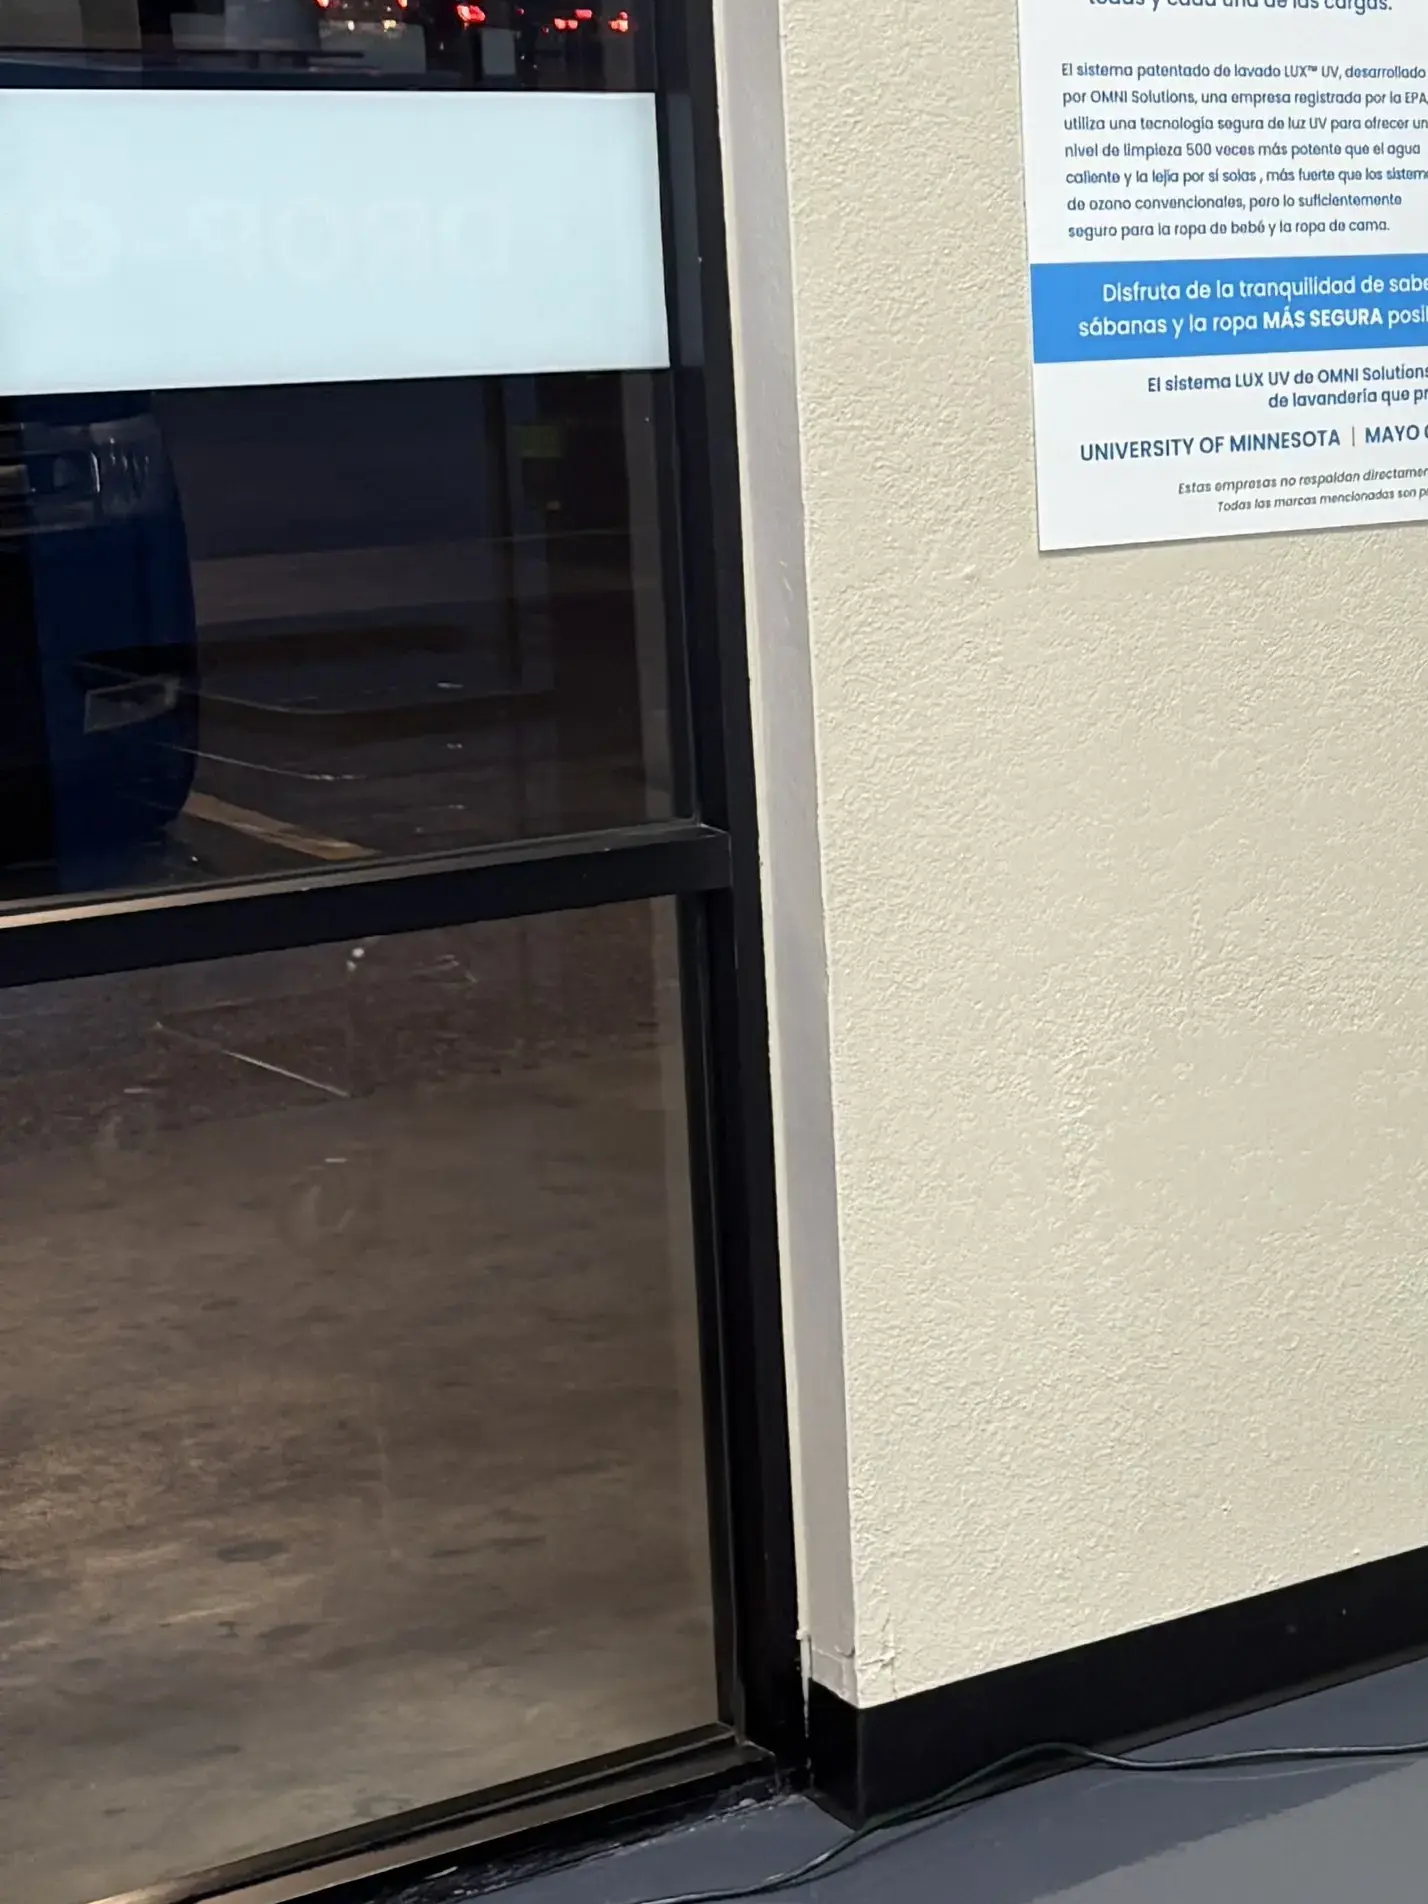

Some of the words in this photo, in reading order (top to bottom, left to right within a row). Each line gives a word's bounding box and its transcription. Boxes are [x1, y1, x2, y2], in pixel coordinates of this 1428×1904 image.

[1062, 92, 1086, 107] por
[1089, 90, 1127, 103] OMNI
[1131, 89, 1198, 105] Solutions,
[1201, 92, 1227, 103] una
[1230, 92, 1291, 108] empresa
[1294, 90, 1361, 108] registrada
[1365, 93, 1386, 108] por
[1389, 90, 1401, 104] la
[1102, 280, 1180, 302] Disfruta
[1185, 279, 1211, 299] de
[1216, 279, 1234, 298] la
[1239, 275, 1356, 302] tranquilidad
[1360, 275, 1384, 293] de
[1078, 316, 1167, 337] sábanas
[1171, 318, 1184, 339] y
[1189, 313, 1207, 332] la
[1212, 315, 1257, 336] ropa
[1262, 305, 1305, 329] MÁS
[1309, 307, 1383, 327] SEGURA
[1080, 437, 1194, 461] UNIVERSITY
[1199, 435, 1224, 454] OF
[1229, 429, 1340, 452] MINNESOTA
[1365, 424, 1420, 443] MAYO
